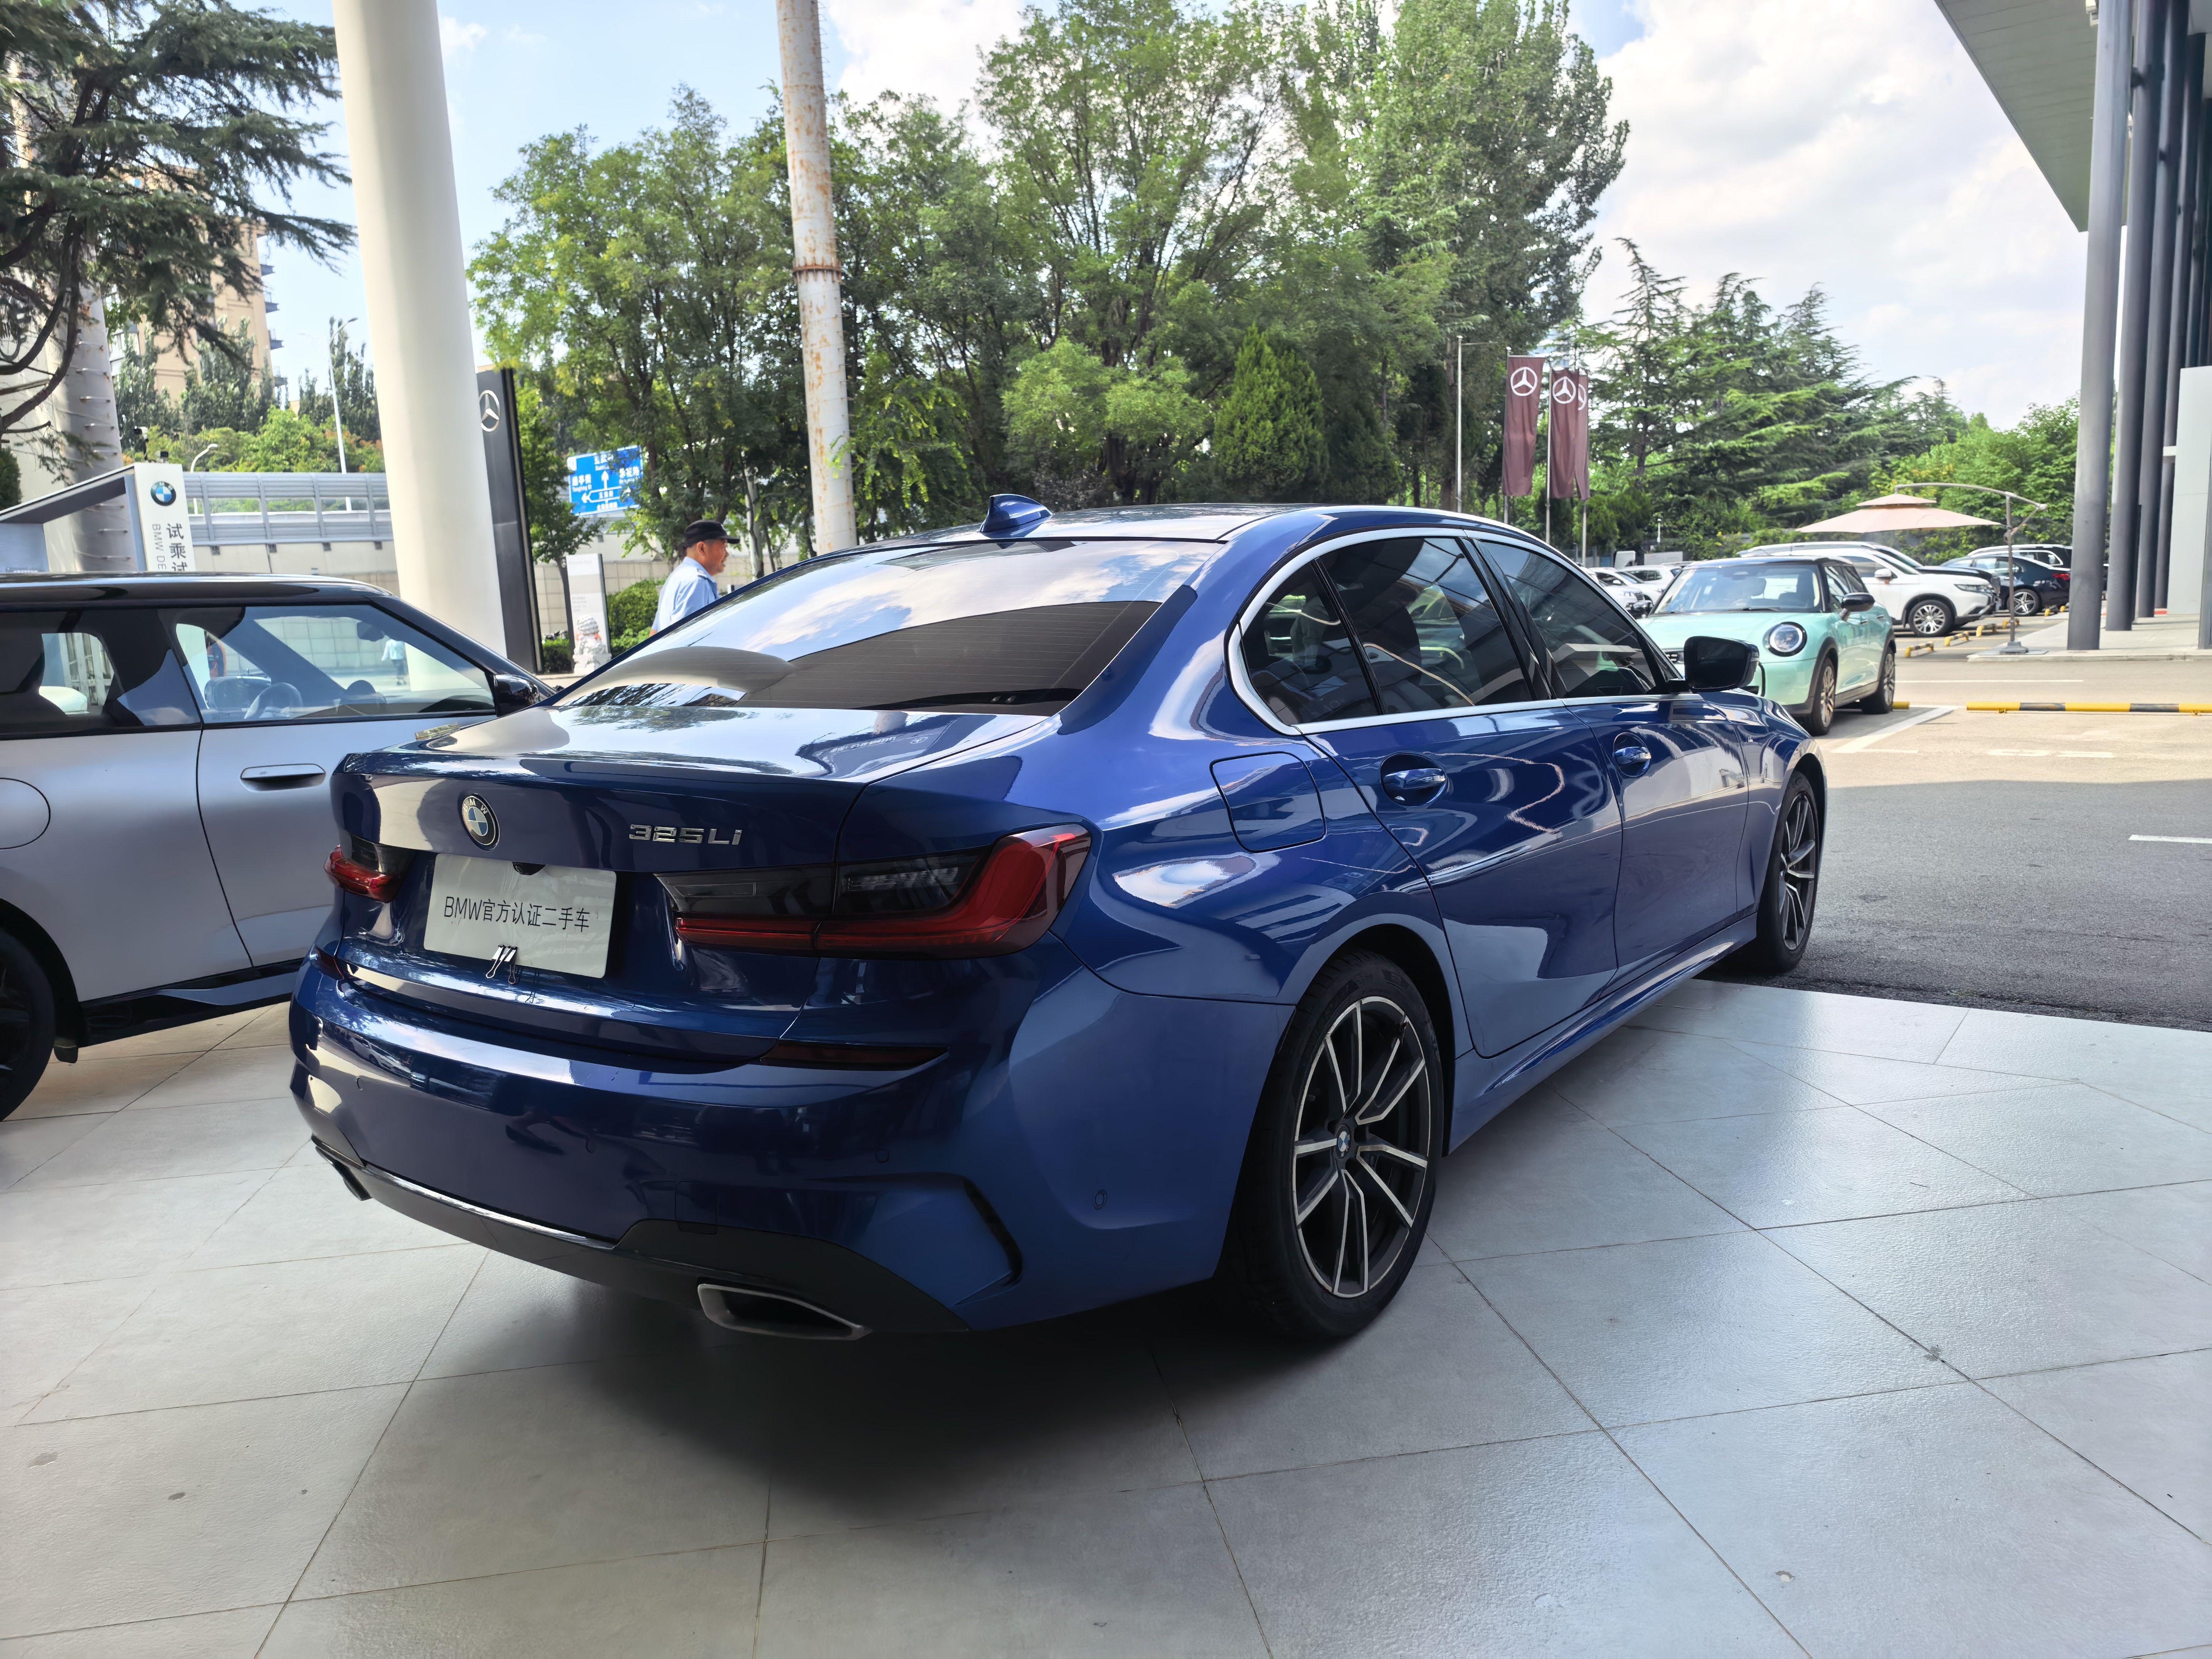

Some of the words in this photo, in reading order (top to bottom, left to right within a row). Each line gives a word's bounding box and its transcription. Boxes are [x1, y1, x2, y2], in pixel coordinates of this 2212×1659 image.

[152, 524, 164, 551] BMW
[463, 798, 488, 814] BMW
[629, 824, 742, 845] 325Li
[444, 896, 590, 933] BMW官方认证二手车
